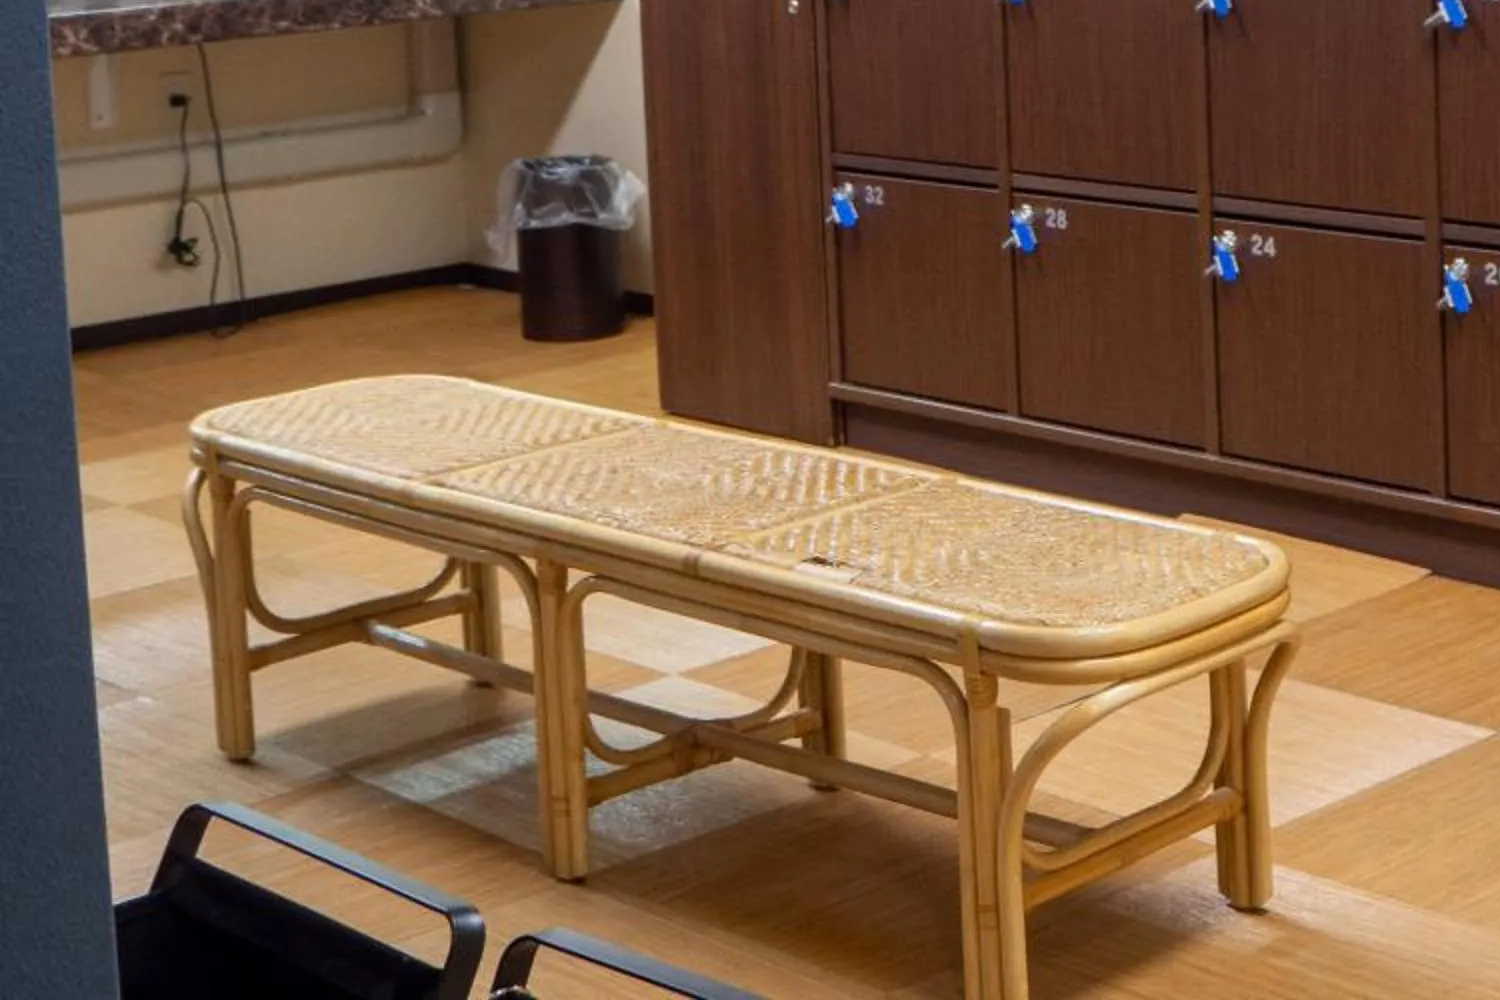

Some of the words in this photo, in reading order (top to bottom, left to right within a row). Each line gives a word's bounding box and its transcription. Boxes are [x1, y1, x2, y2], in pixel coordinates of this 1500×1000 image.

[864, 184, 884, 206] 32
[1044, 207, 1068, 230] 28
[1250, 233, 1277, 257] 24
